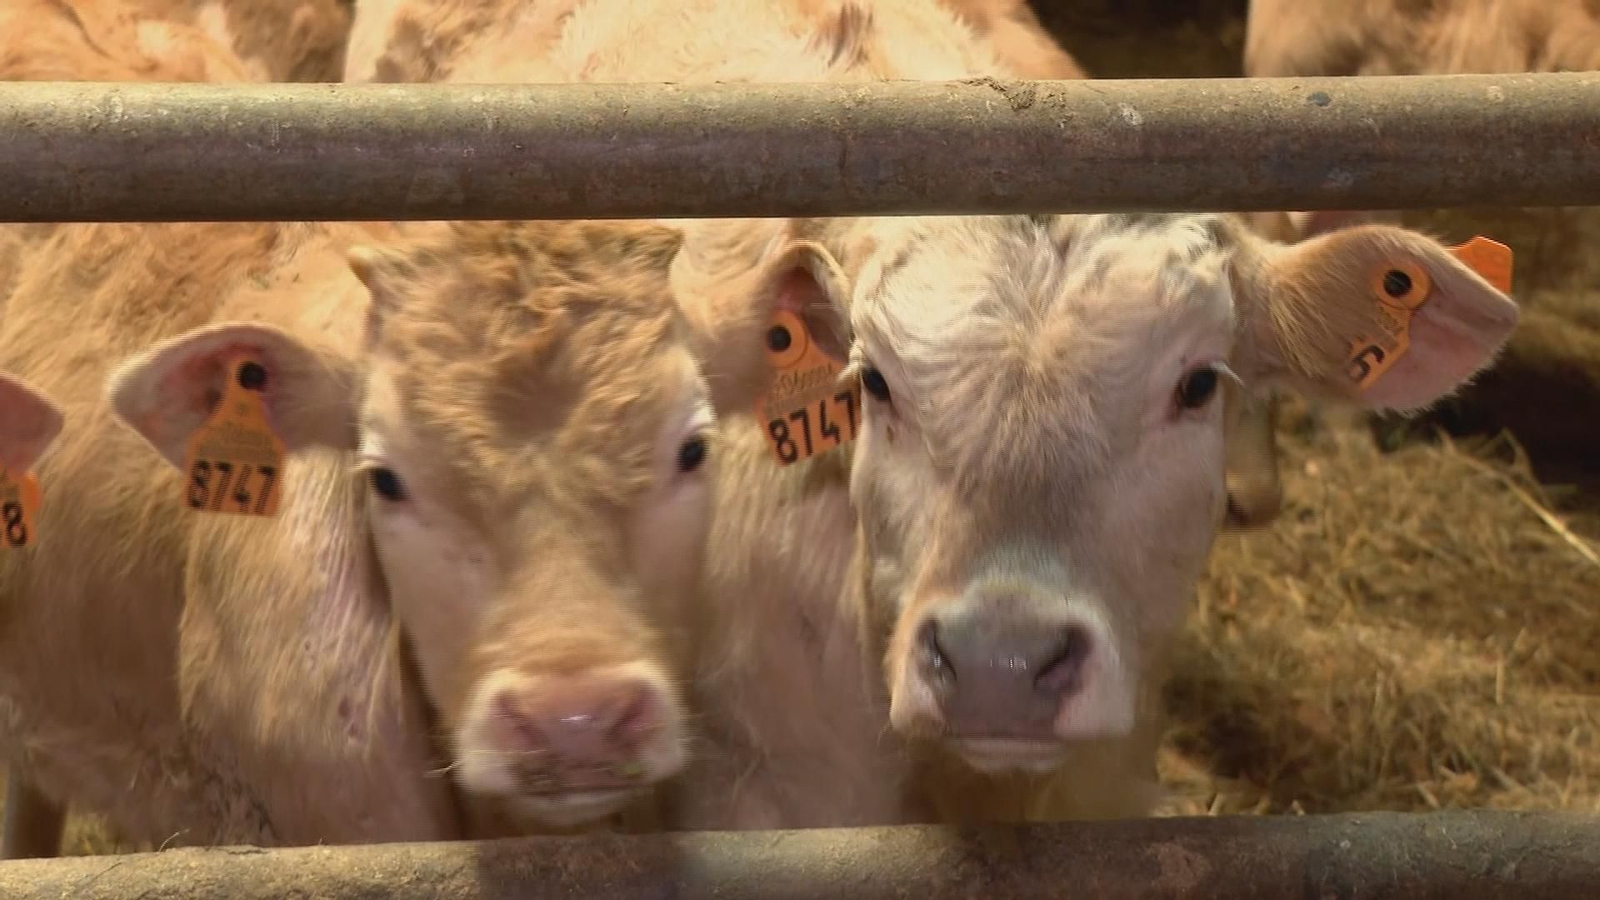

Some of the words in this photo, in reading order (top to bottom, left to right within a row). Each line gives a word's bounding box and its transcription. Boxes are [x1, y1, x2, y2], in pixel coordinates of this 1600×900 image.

[1346, 335, 1385, 384] 6
[768, 388, 856, 464] 8747
[187, 459, 276, 514] 8747
[0, 501, 28, 548] 8
